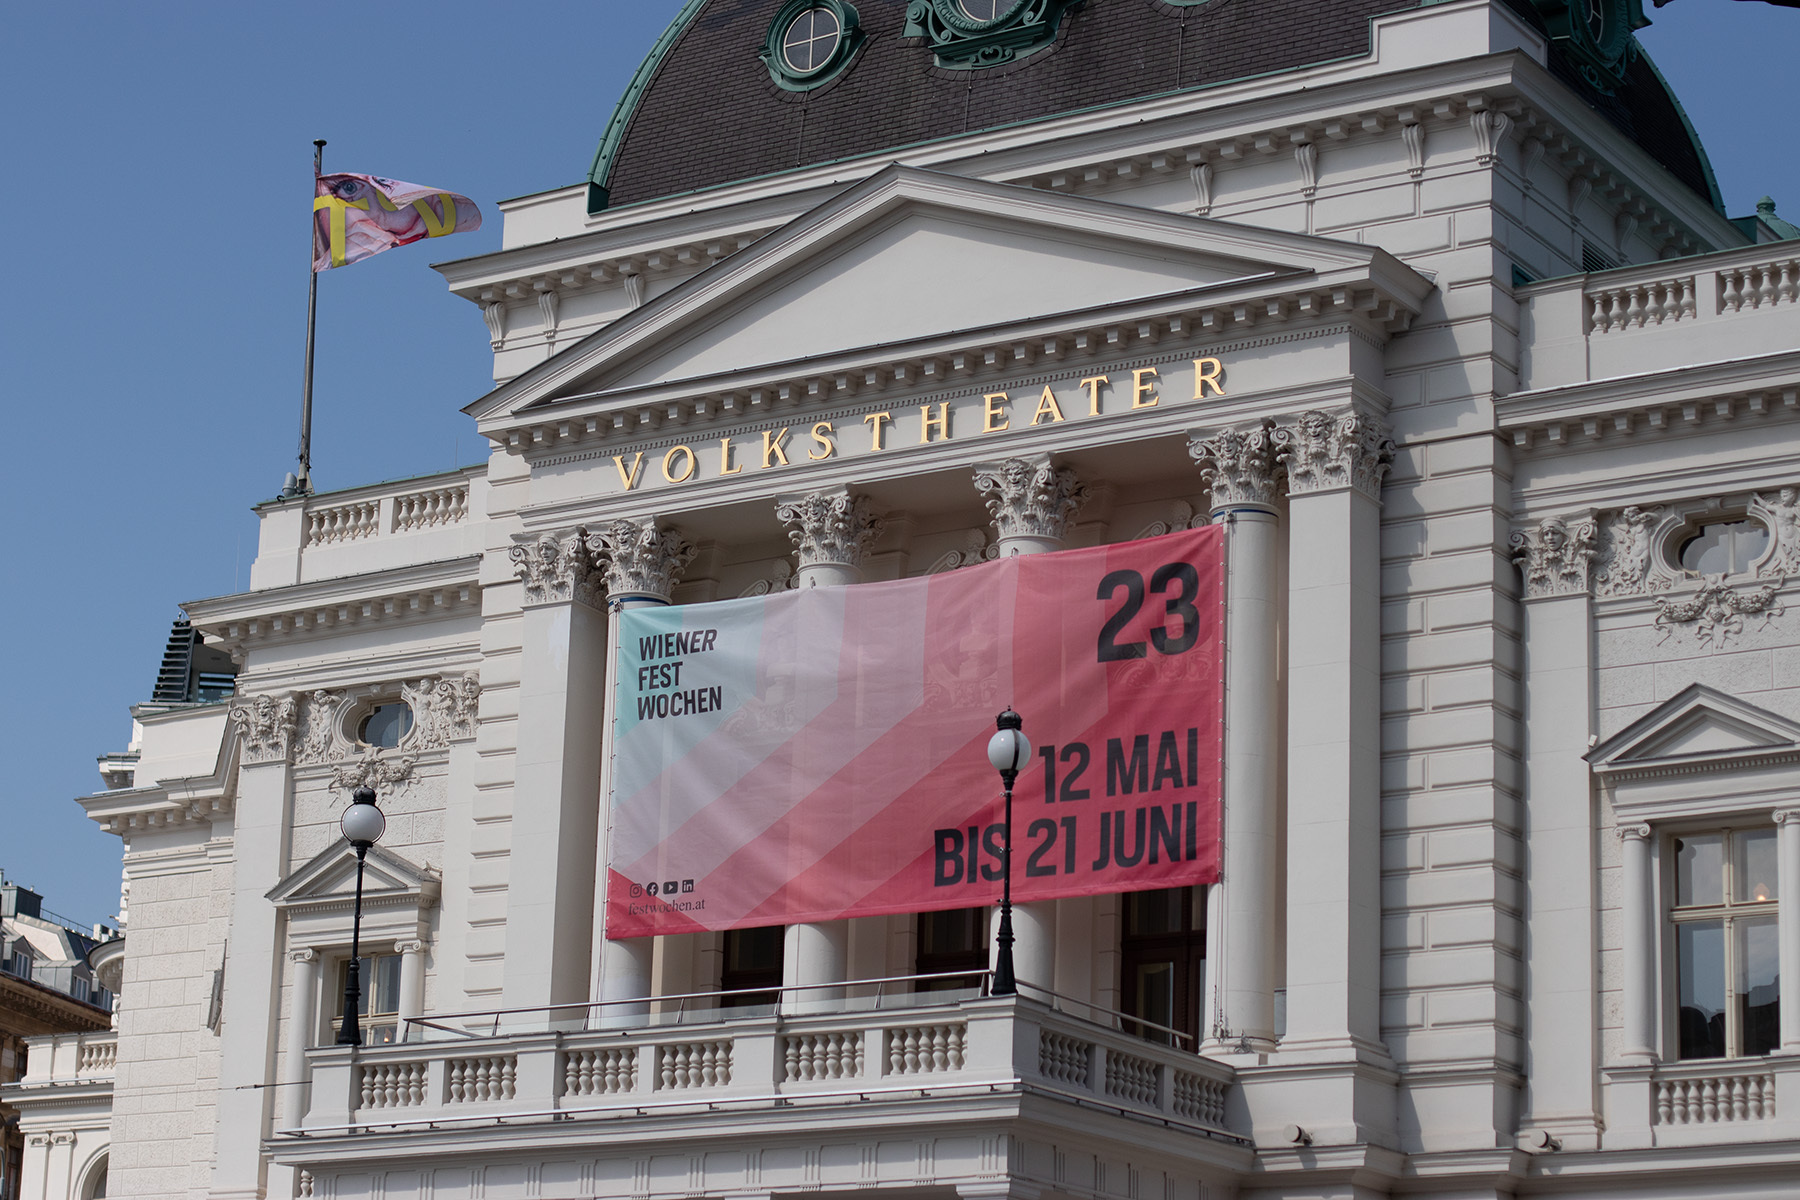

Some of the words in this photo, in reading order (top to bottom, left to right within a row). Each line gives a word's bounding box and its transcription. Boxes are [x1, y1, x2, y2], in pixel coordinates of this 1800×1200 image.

[612, 356, 1226, 491] VOLKSTHEATER
[1096, 561, 1201, 664] 23
[638, 628, 718, 662] WIENER
[637, 685, 723, 721] WOCHEN
[638, 661, 684, 692] FEST
[1038, 742, 1092, 804] 12
[1106, 727, 1199, 798] MAI
[934, 822, 1008, 888] BIS
[1026, 816, 1078, 879] 21
[1092, 801, 1198, 873] JUNI
[628, 898, 706, 916] festwochen.at
